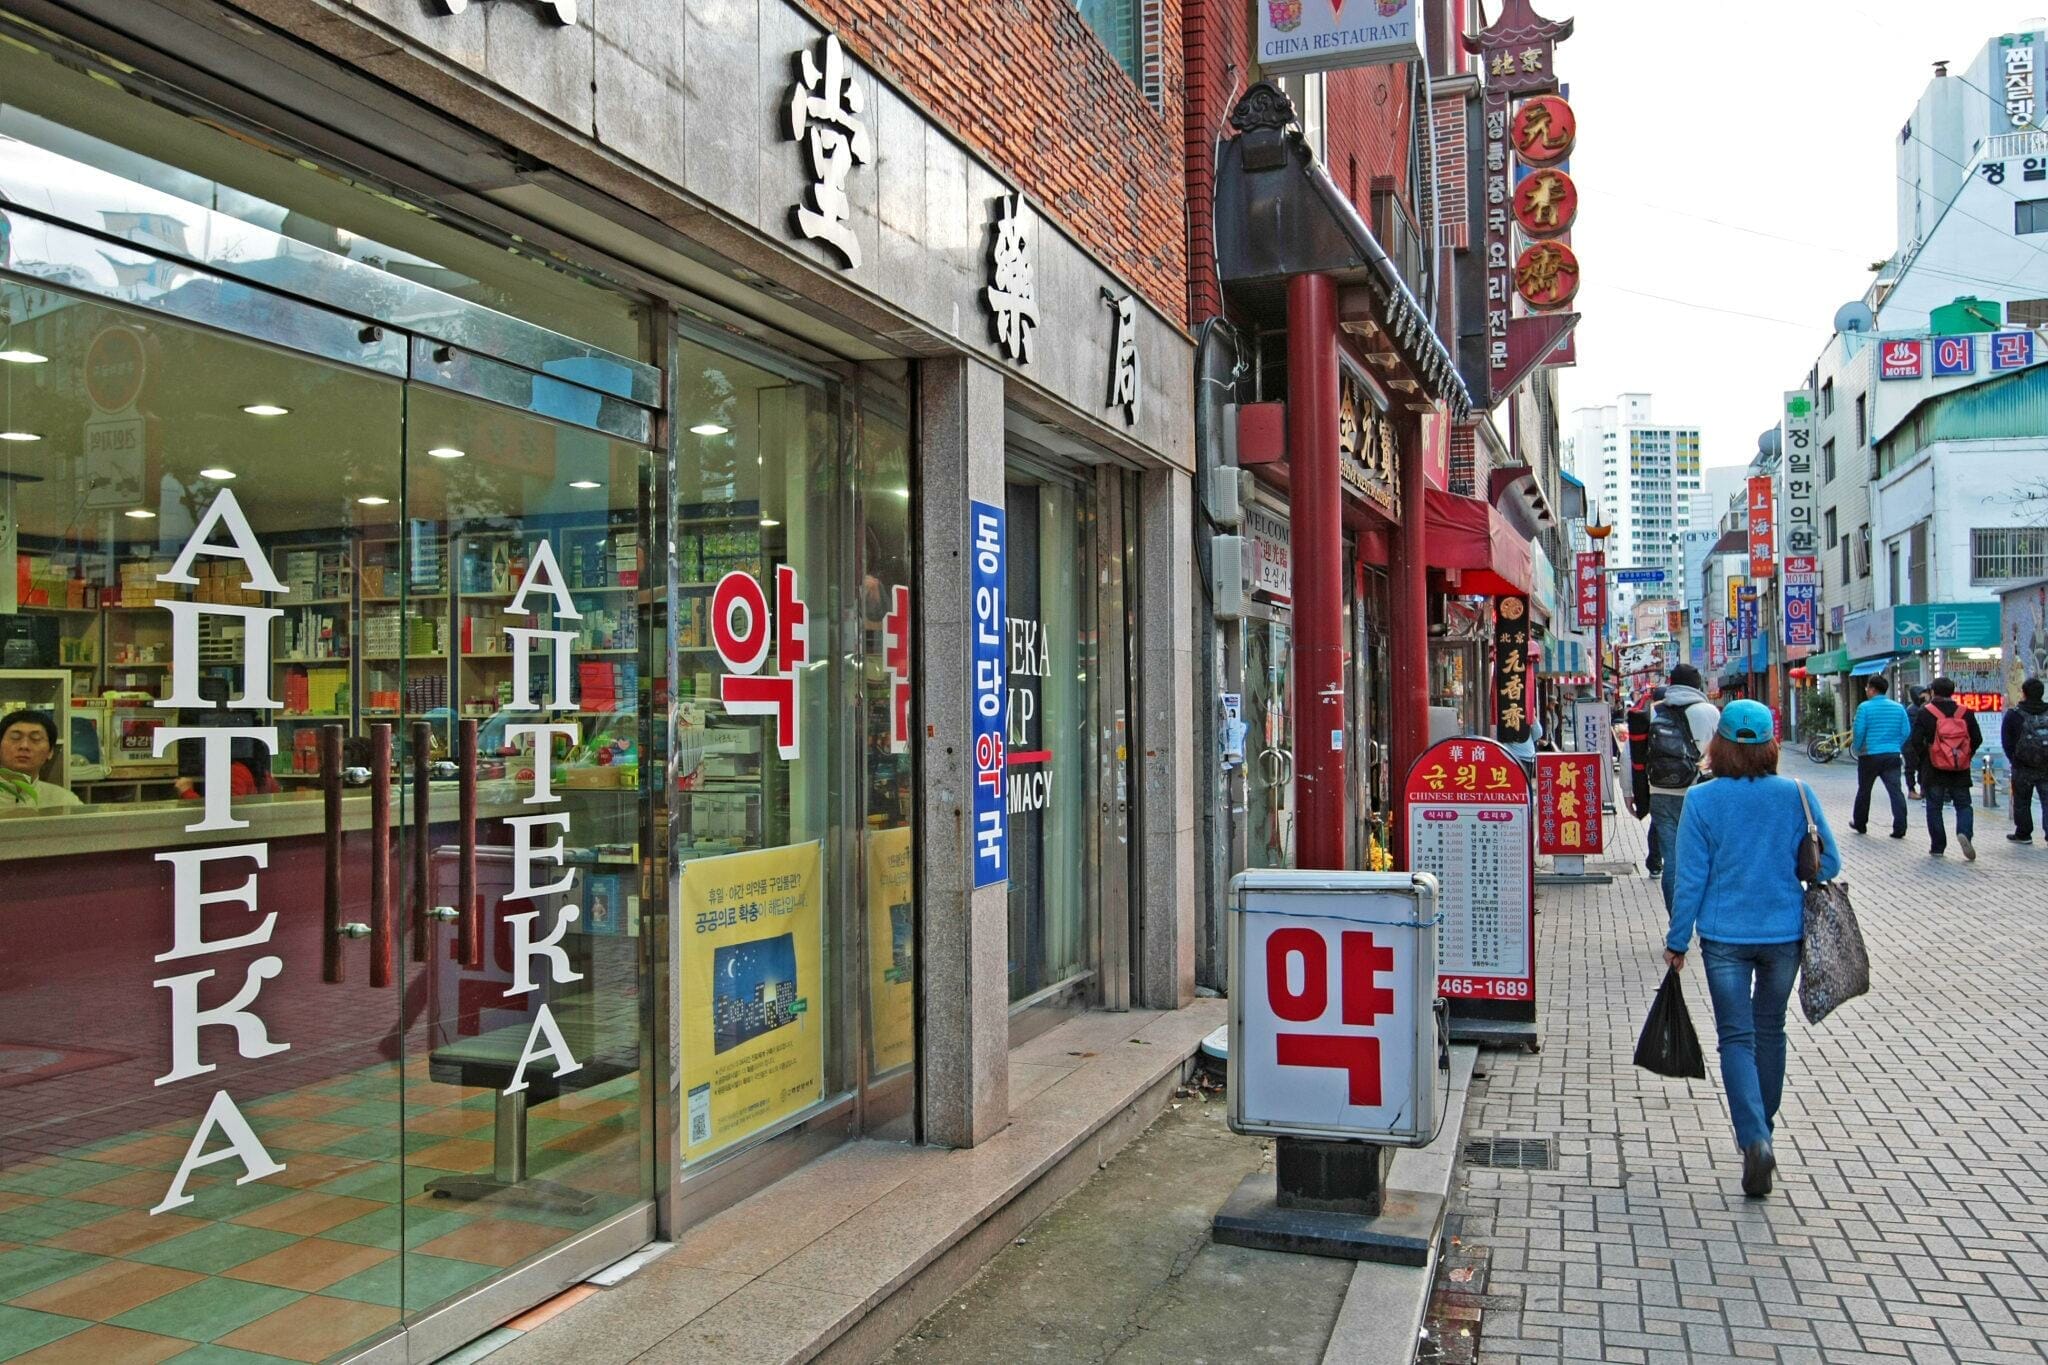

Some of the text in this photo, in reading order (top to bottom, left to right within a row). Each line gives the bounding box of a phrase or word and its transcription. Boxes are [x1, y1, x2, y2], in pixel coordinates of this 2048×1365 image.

[1265, 22, 1410, 56] CHINA RESTAURANT
[2005, 46, 2035, 127] 찜질방
[1938, 334, 2030, 372] 여관
[1885, 366, 1919, 377] MOTEL
[1788, 428, 1812, 552] 정일한의원
[1254, 536, 1288, 569] 迎光臨
[1264, 566, 1291, 593] 오십시
[1785, 574, 1815, 585] MOTEL
[1500, 631, 1526, 644] 北京
[1788, 599, 1815, 644] 여관
[711, 563, 810, 760] 약
[1005, 617, 1052, 677] ЕКА
[976, 514, 1004, 870] 동인당약국
[1585, 715, 1597, 753] PHON
[1449, 745, 1486, 763] 華商
[1006, 770, 1053, 816] MACY
[1409, 792, 1528, 802] CHINESE RESTAURANT
[695, 908, 737, 934] 공공의료
